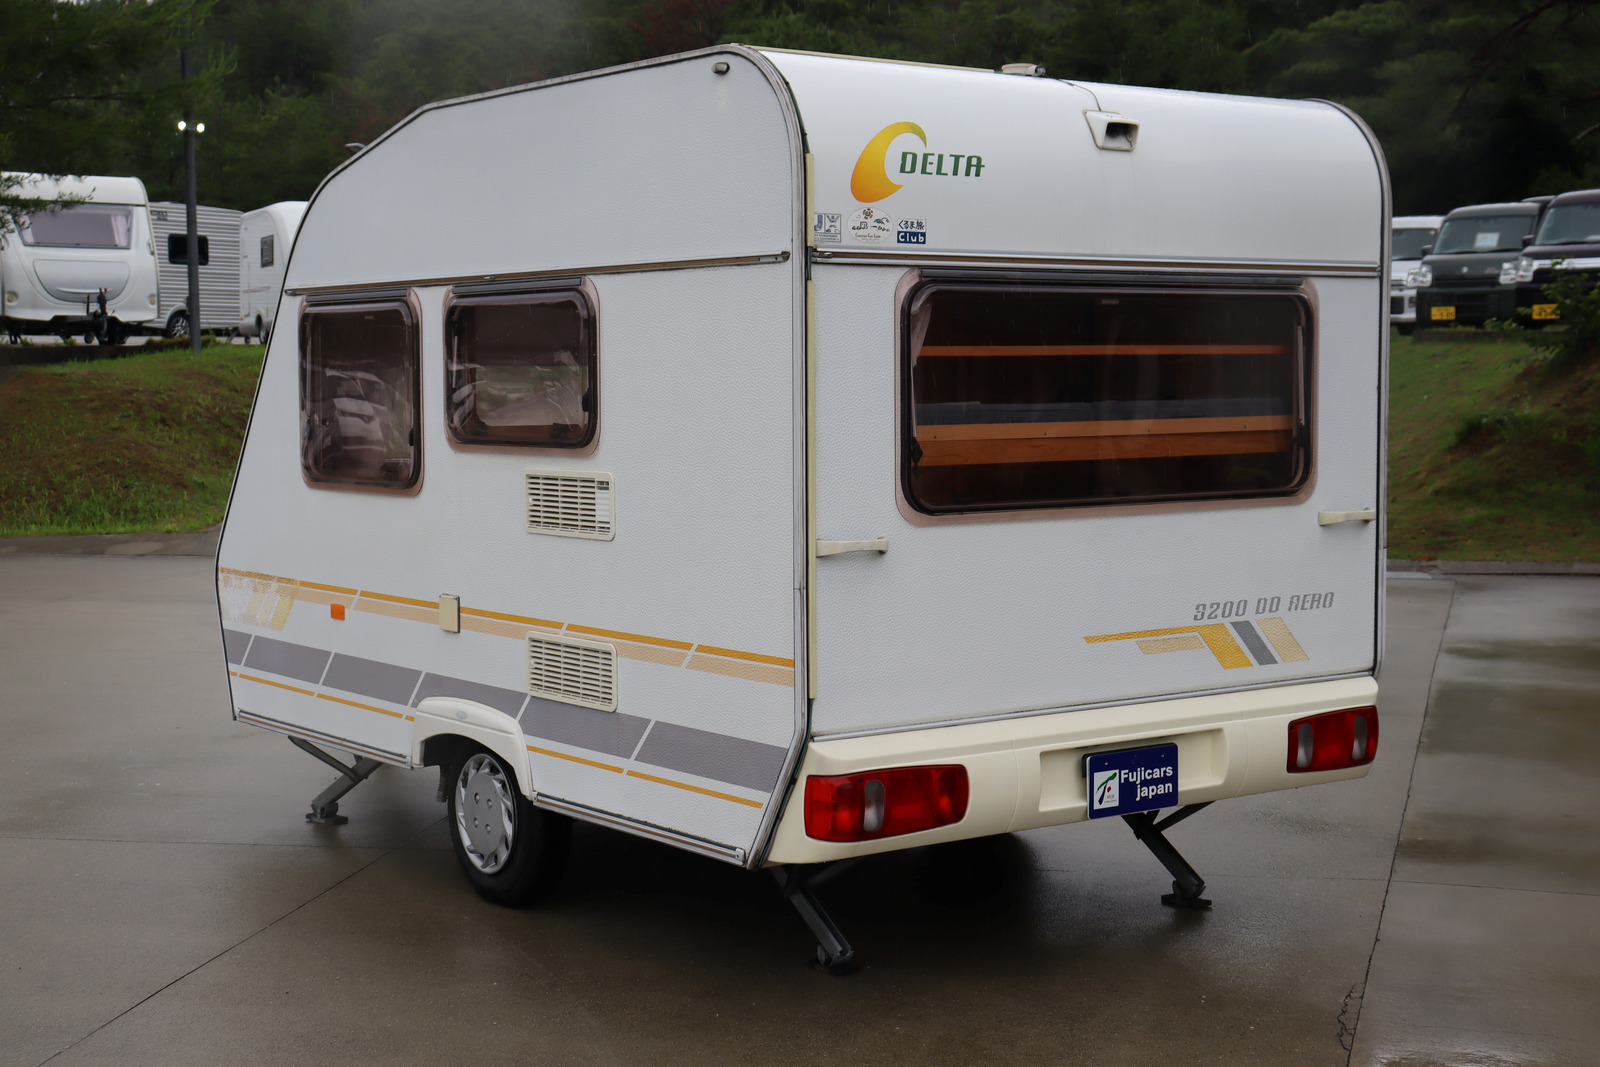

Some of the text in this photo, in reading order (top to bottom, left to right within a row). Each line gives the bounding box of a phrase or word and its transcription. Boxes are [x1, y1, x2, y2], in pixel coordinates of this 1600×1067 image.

[899, 151, 985, 178] DELTA
[898, 219, 925, 231] くるま旅
[898, 232, 925, 243] Club
[1193, 598, 1248, 621] 3200
[1288, 591, 1335, 612] AERO
[1120, 766, 1173, 785] Fujicars
[1136, 782, 1173, 802] japan
